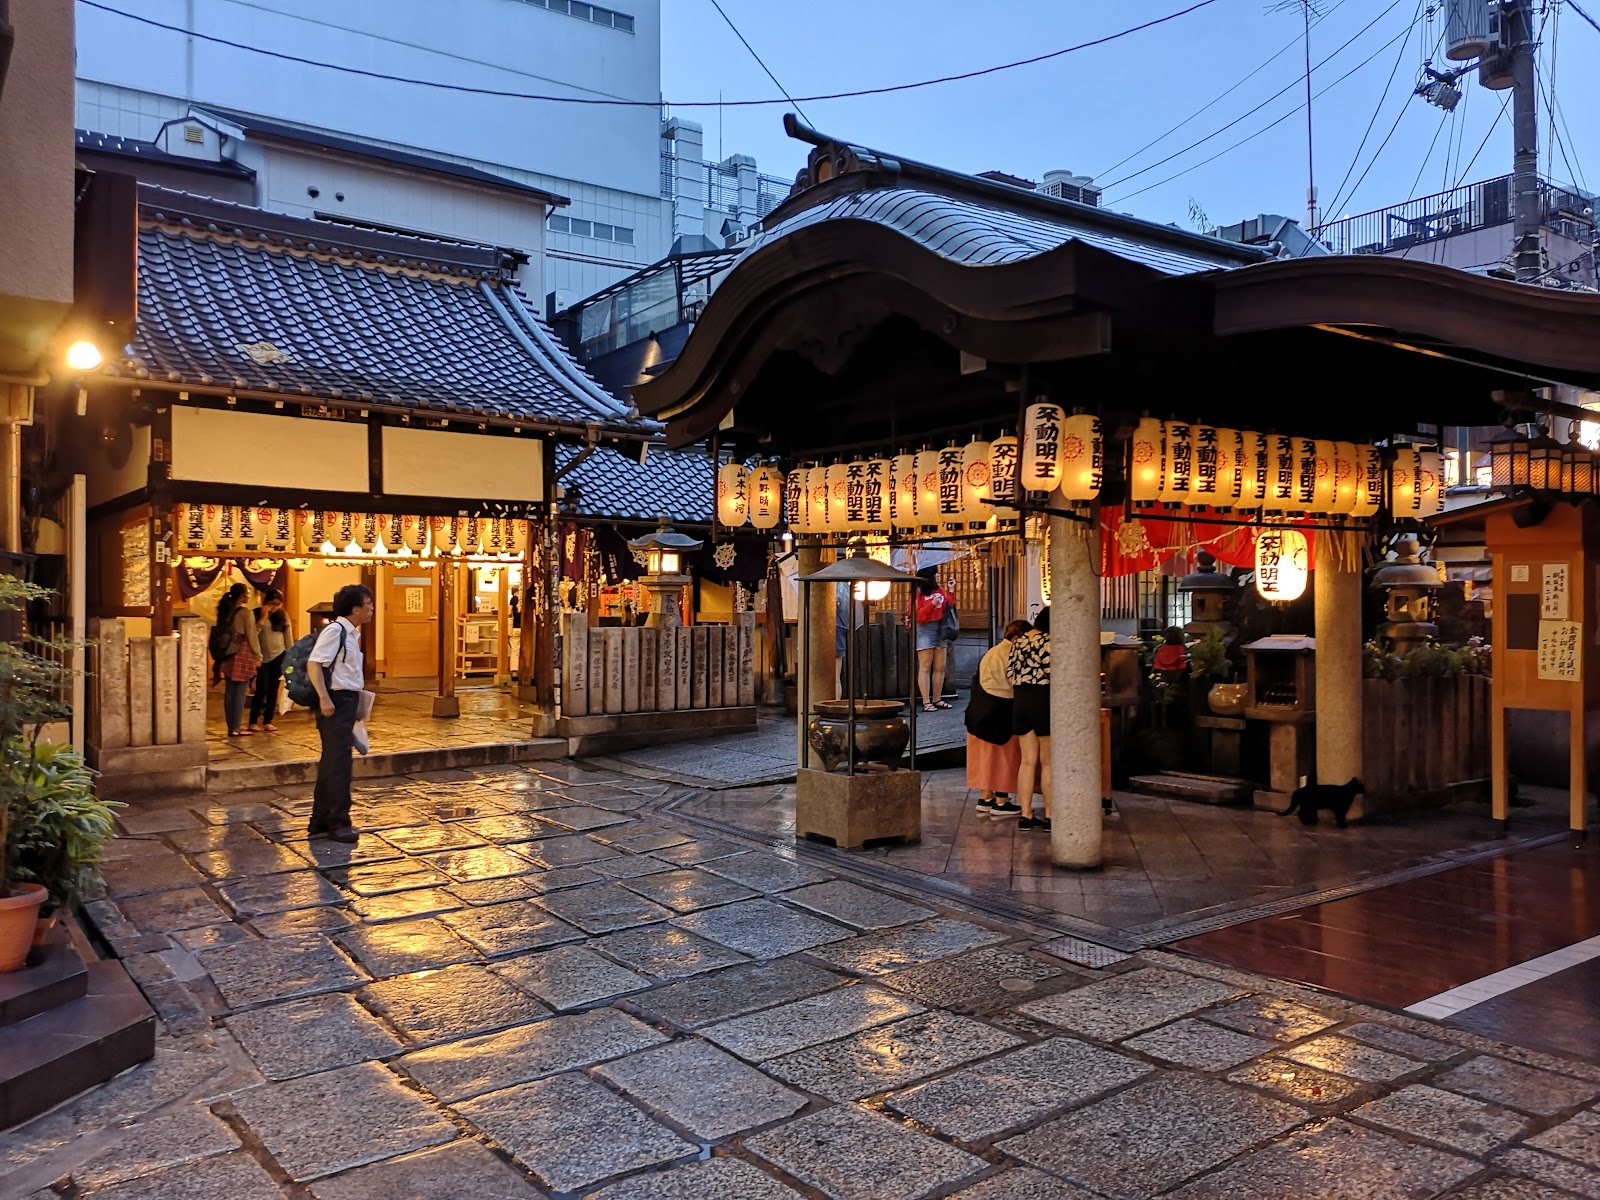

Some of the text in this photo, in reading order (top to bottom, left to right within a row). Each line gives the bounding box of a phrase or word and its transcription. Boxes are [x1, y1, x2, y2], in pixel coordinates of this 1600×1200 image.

[1035, 407, 1060, 478] 不動明王
[1172, 425, 1191, 492] 不動明王
[1197, 428, 1217, 493] 不動明王
[1299, 440, 1315, 503] 不動明王
[735, 468, 747, 514] 山本大河
[758, 471, 770, 517] 山野晴三
[788, 472, 801, 525] 不動明王
[847, 464, 864, 522] 不動明王
[866, 462, 883, 524] 不動明王
[939, 450, 963, 514] 不動明王
[1260, 536, 1280, 592] 不動明王
